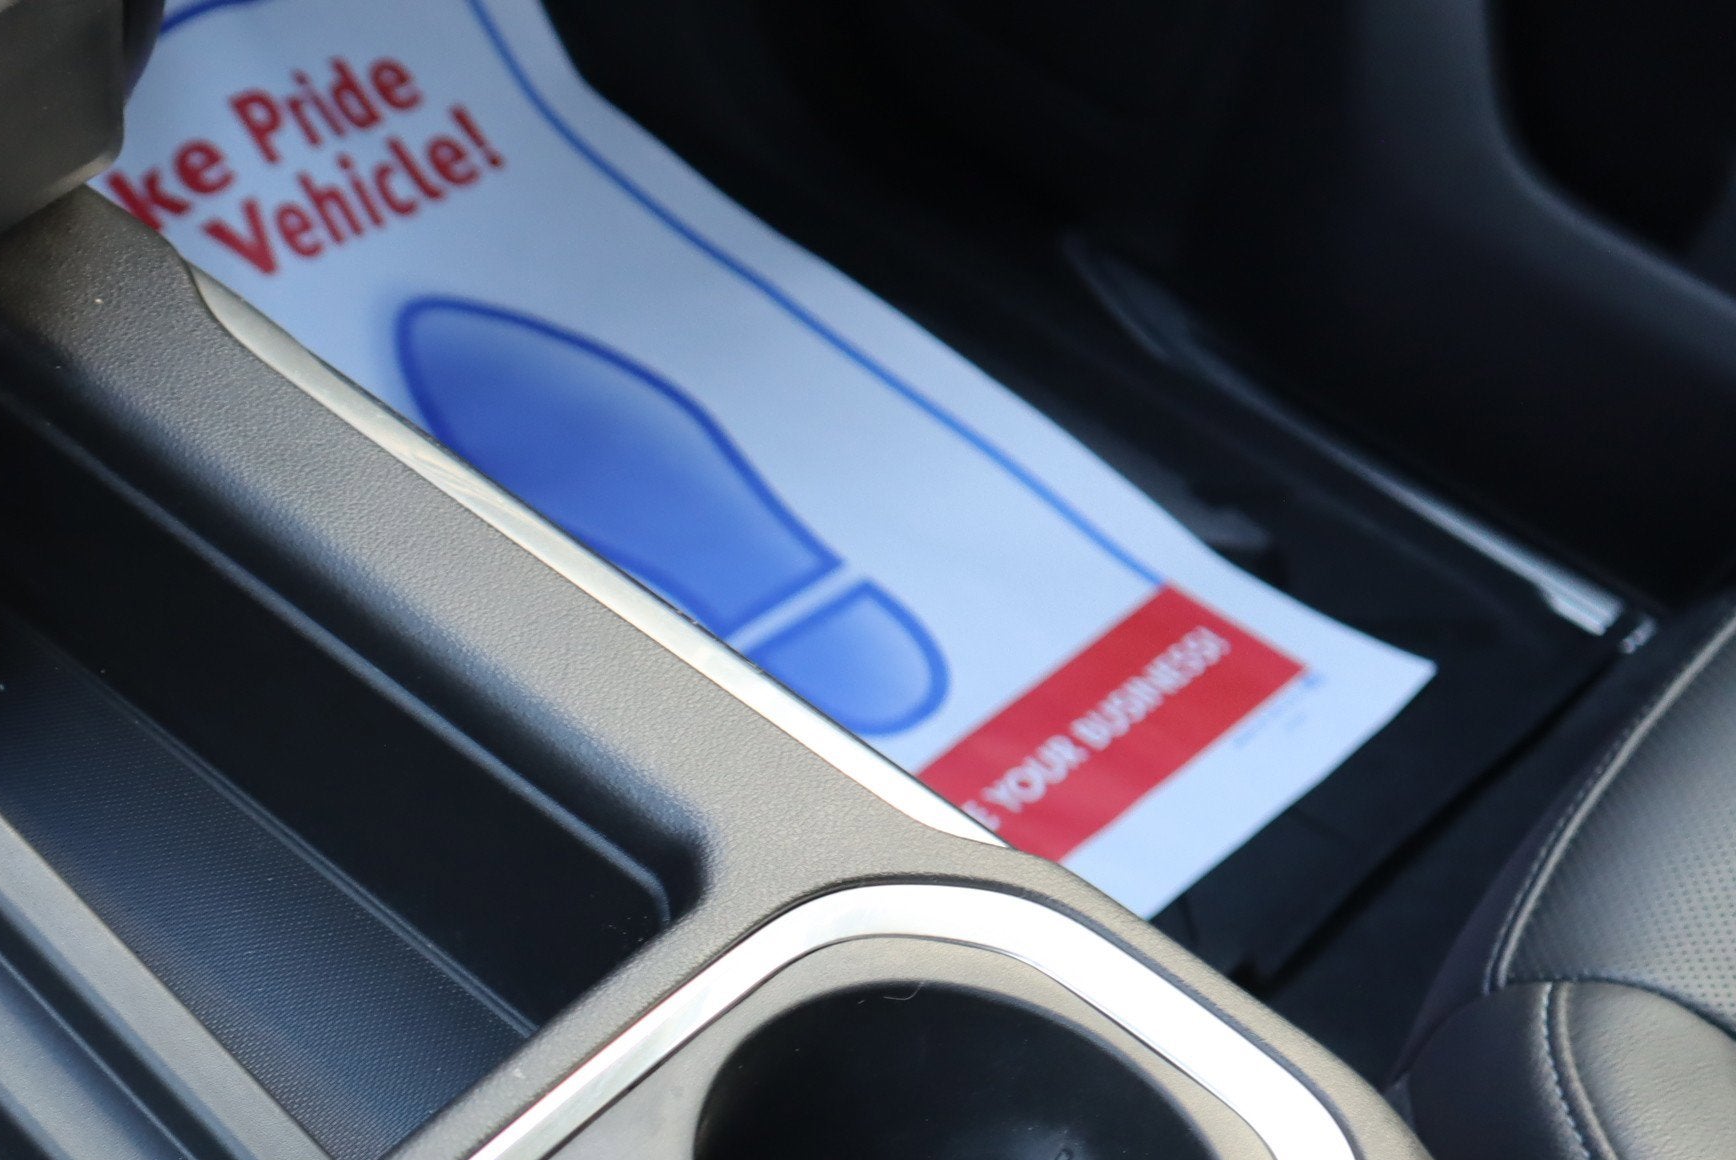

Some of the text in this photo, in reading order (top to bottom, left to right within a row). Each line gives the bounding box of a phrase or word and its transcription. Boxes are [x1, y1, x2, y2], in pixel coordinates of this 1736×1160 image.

[228, 55, 424, 164] Pride
[203, 103, 504, 276] Vehicle!
[981, 734, 1089, 813] YOUR
